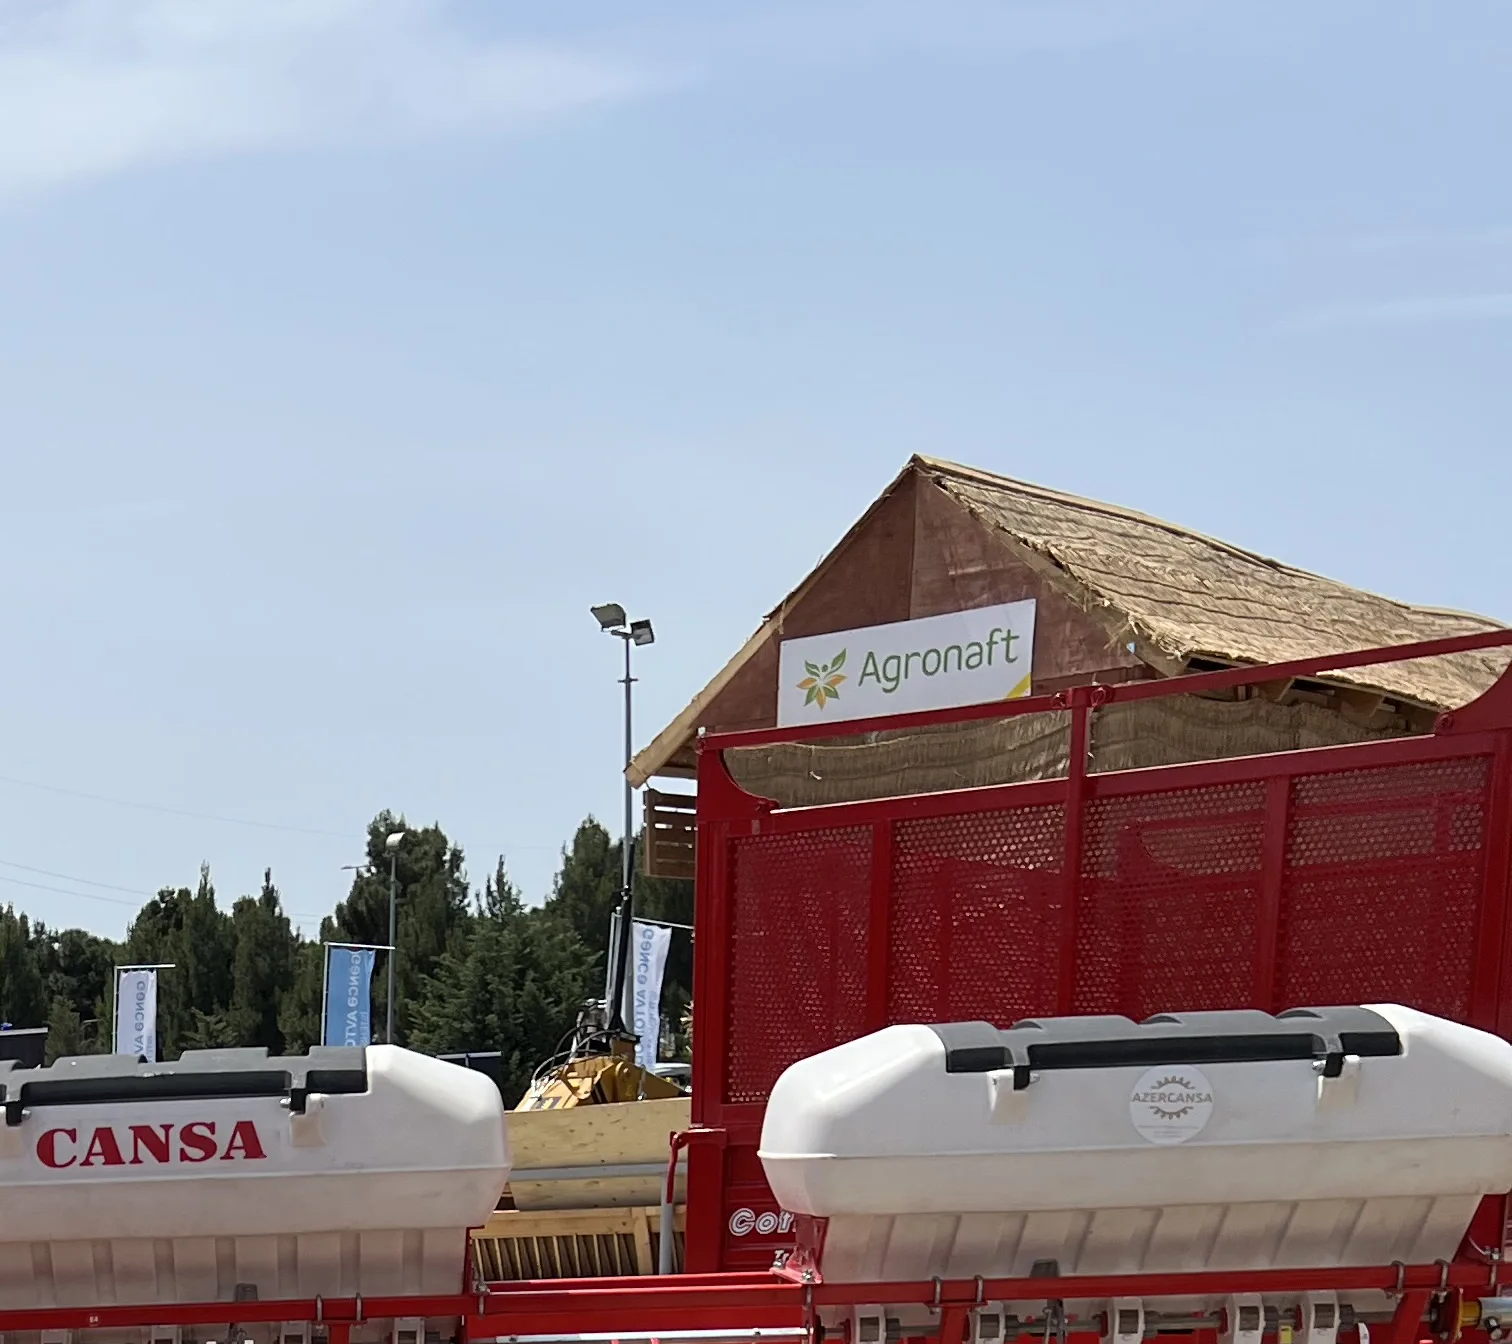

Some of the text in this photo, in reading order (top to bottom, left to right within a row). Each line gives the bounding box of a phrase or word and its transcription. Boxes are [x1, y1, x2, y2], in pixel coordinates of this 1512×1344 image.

[858, 628, 1020, 694] Agronaft
[1132, 1092, 1213, 1103] AZERCANSA
[36, 1120, 267, 1169] CANSA
